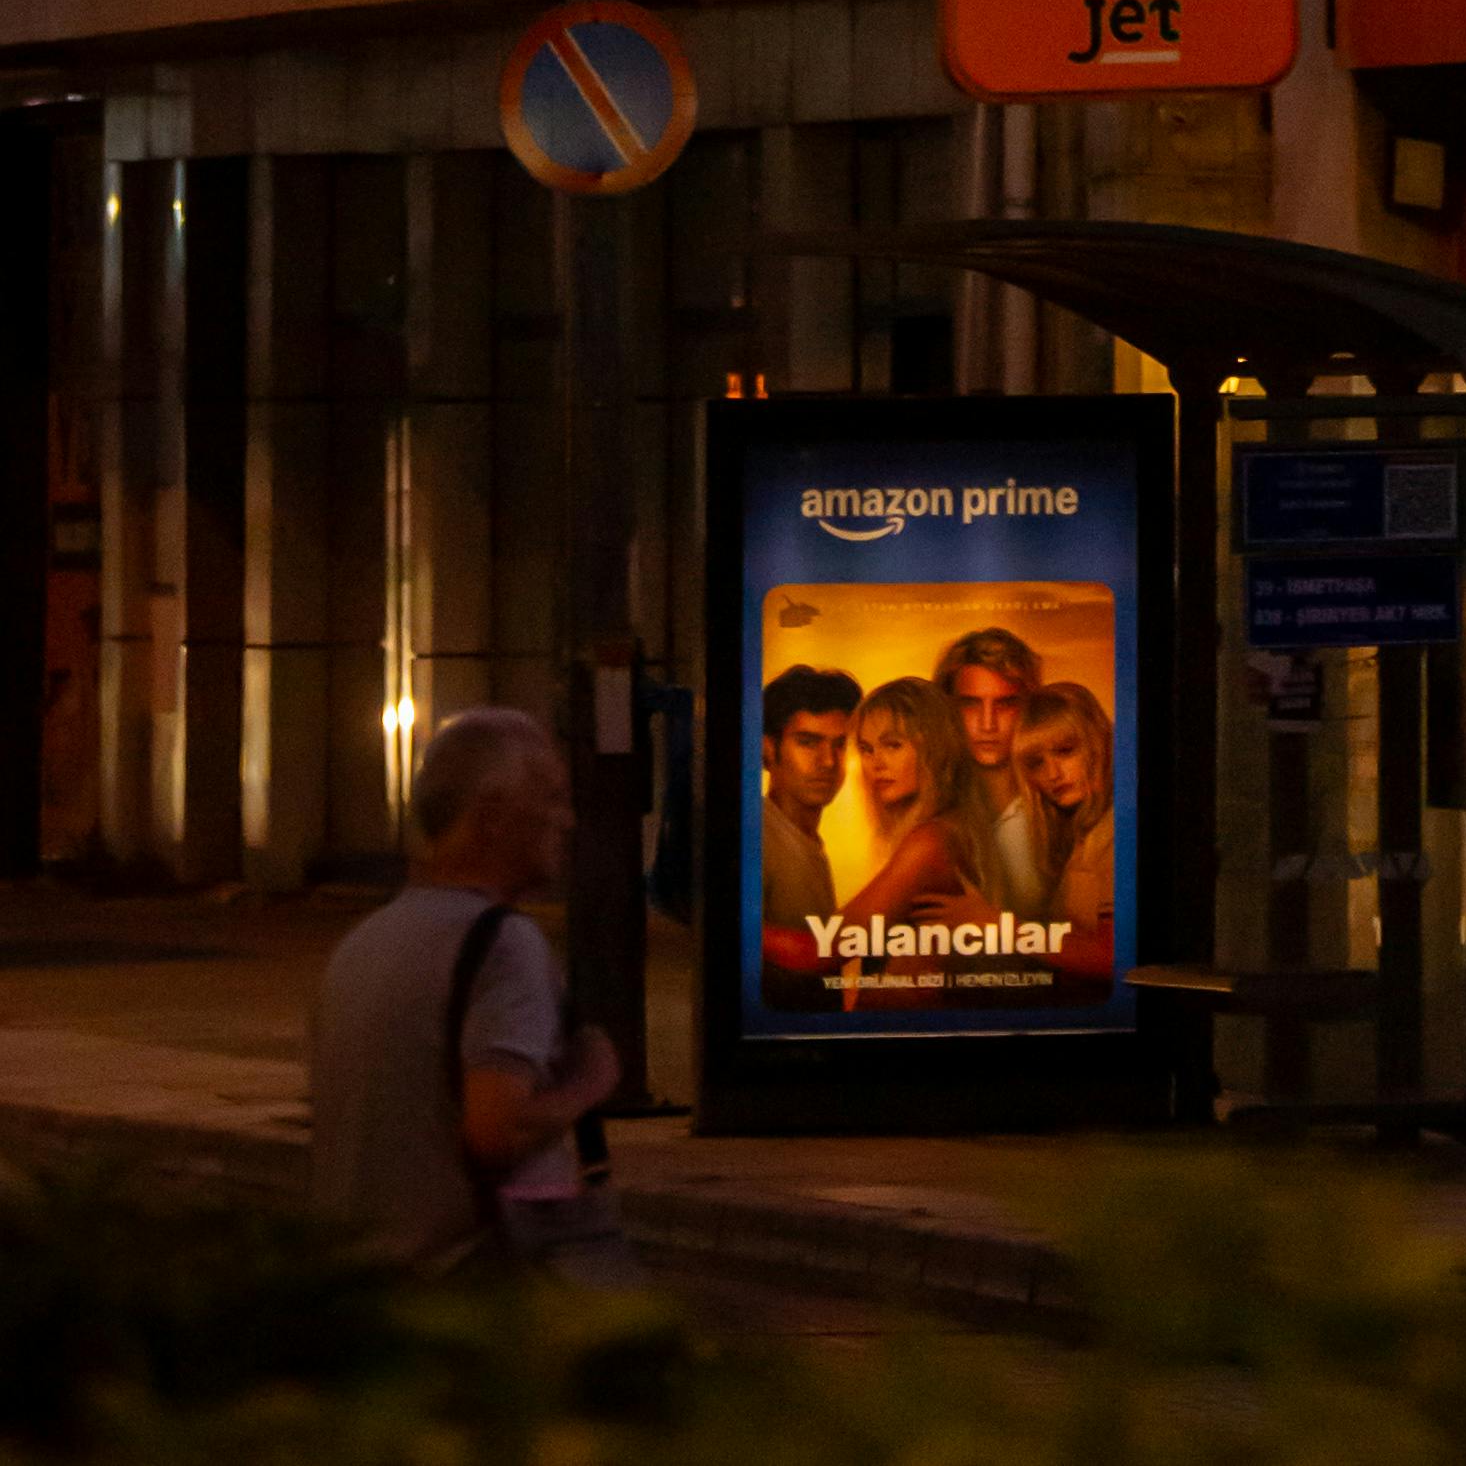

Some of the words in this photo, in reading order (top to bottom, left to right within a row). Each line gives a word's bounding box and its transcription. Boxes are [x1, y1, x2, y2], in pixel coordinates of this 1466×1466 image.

[801, 487, 954, 518] amazon
[962, 477, 1079, 525] prime
[805, 911, 1072, 959] Yalancılar
